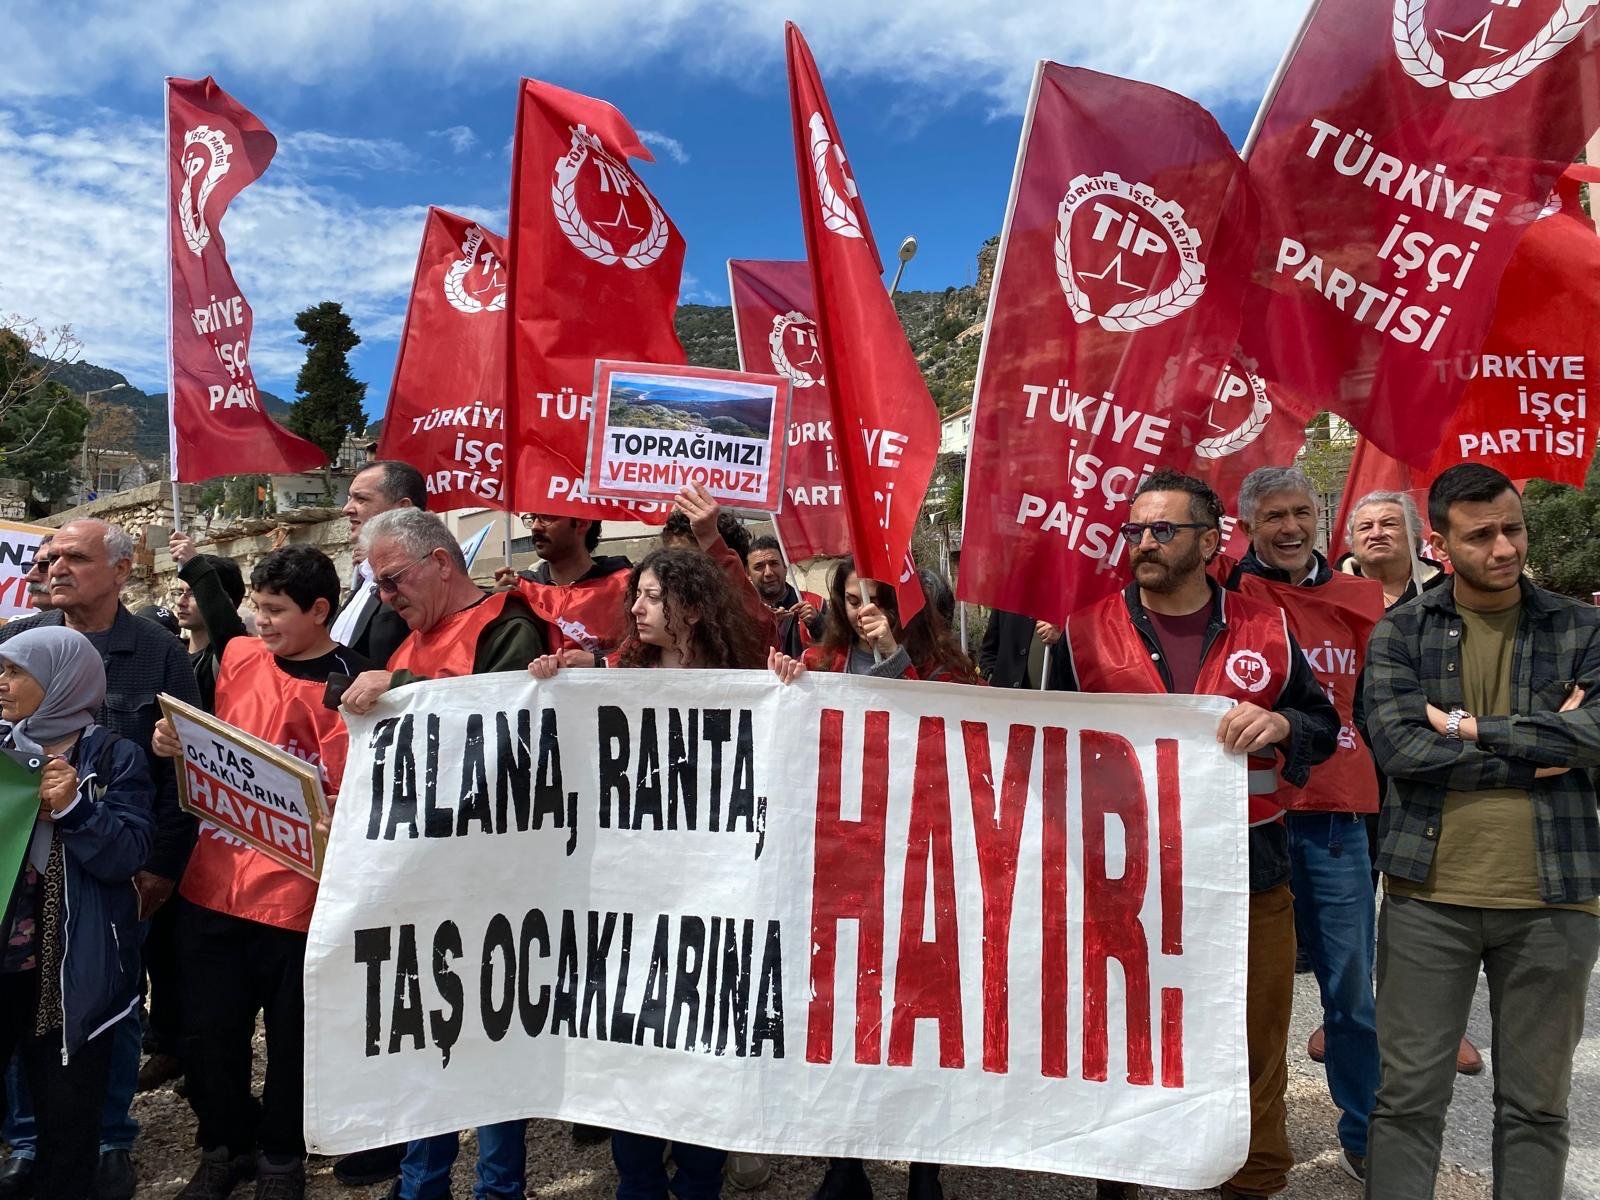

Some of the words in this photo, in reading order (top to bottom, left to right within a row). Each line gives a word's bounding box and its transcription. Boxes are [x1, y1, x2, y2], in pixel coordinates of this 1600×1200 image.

[1306, 118, 1502, 232] TÜRKİYE
[1064, 178, 1119, 214] TÜRKİYE
[1128, 185, 1159, 209] İŞÇİ
[1161, 210, 1198, 265] PARTİSİ
[1091, 202, 1168, 257] TİP
[1377, 214, 1480, 292] İŞÇİ
[1275, 237, 1452, 352] PARTİSİ
[791, 326, 818, 348] Tİ
[411, 400, 504, 435] TÜRKİY
[1518, 385, 1587, 426] İŞÇİ
[454, 432, 504, 473] İŞÇ
[611, 433, 764, 467] TOPRAĞIMIZI
[1458, 423, 1586, 459] PARTİSİ
[426, 470, 504, 501] ARTİS
[607, 459, 763, 494] VERMİYORUZ!
[187, 744, 303, 817] OCAKLARINA
[365, 707, 579, 857] TALANA,
[598, 705, 768, 860] RANTA,
[189, 768, 310, 860] HAYIR!
[805, 708, 1185, 1089] HAYIR!
[354, 919, 464, 1070] TAŞ
[480, 907, 786, 1059] OCAKLARINA
